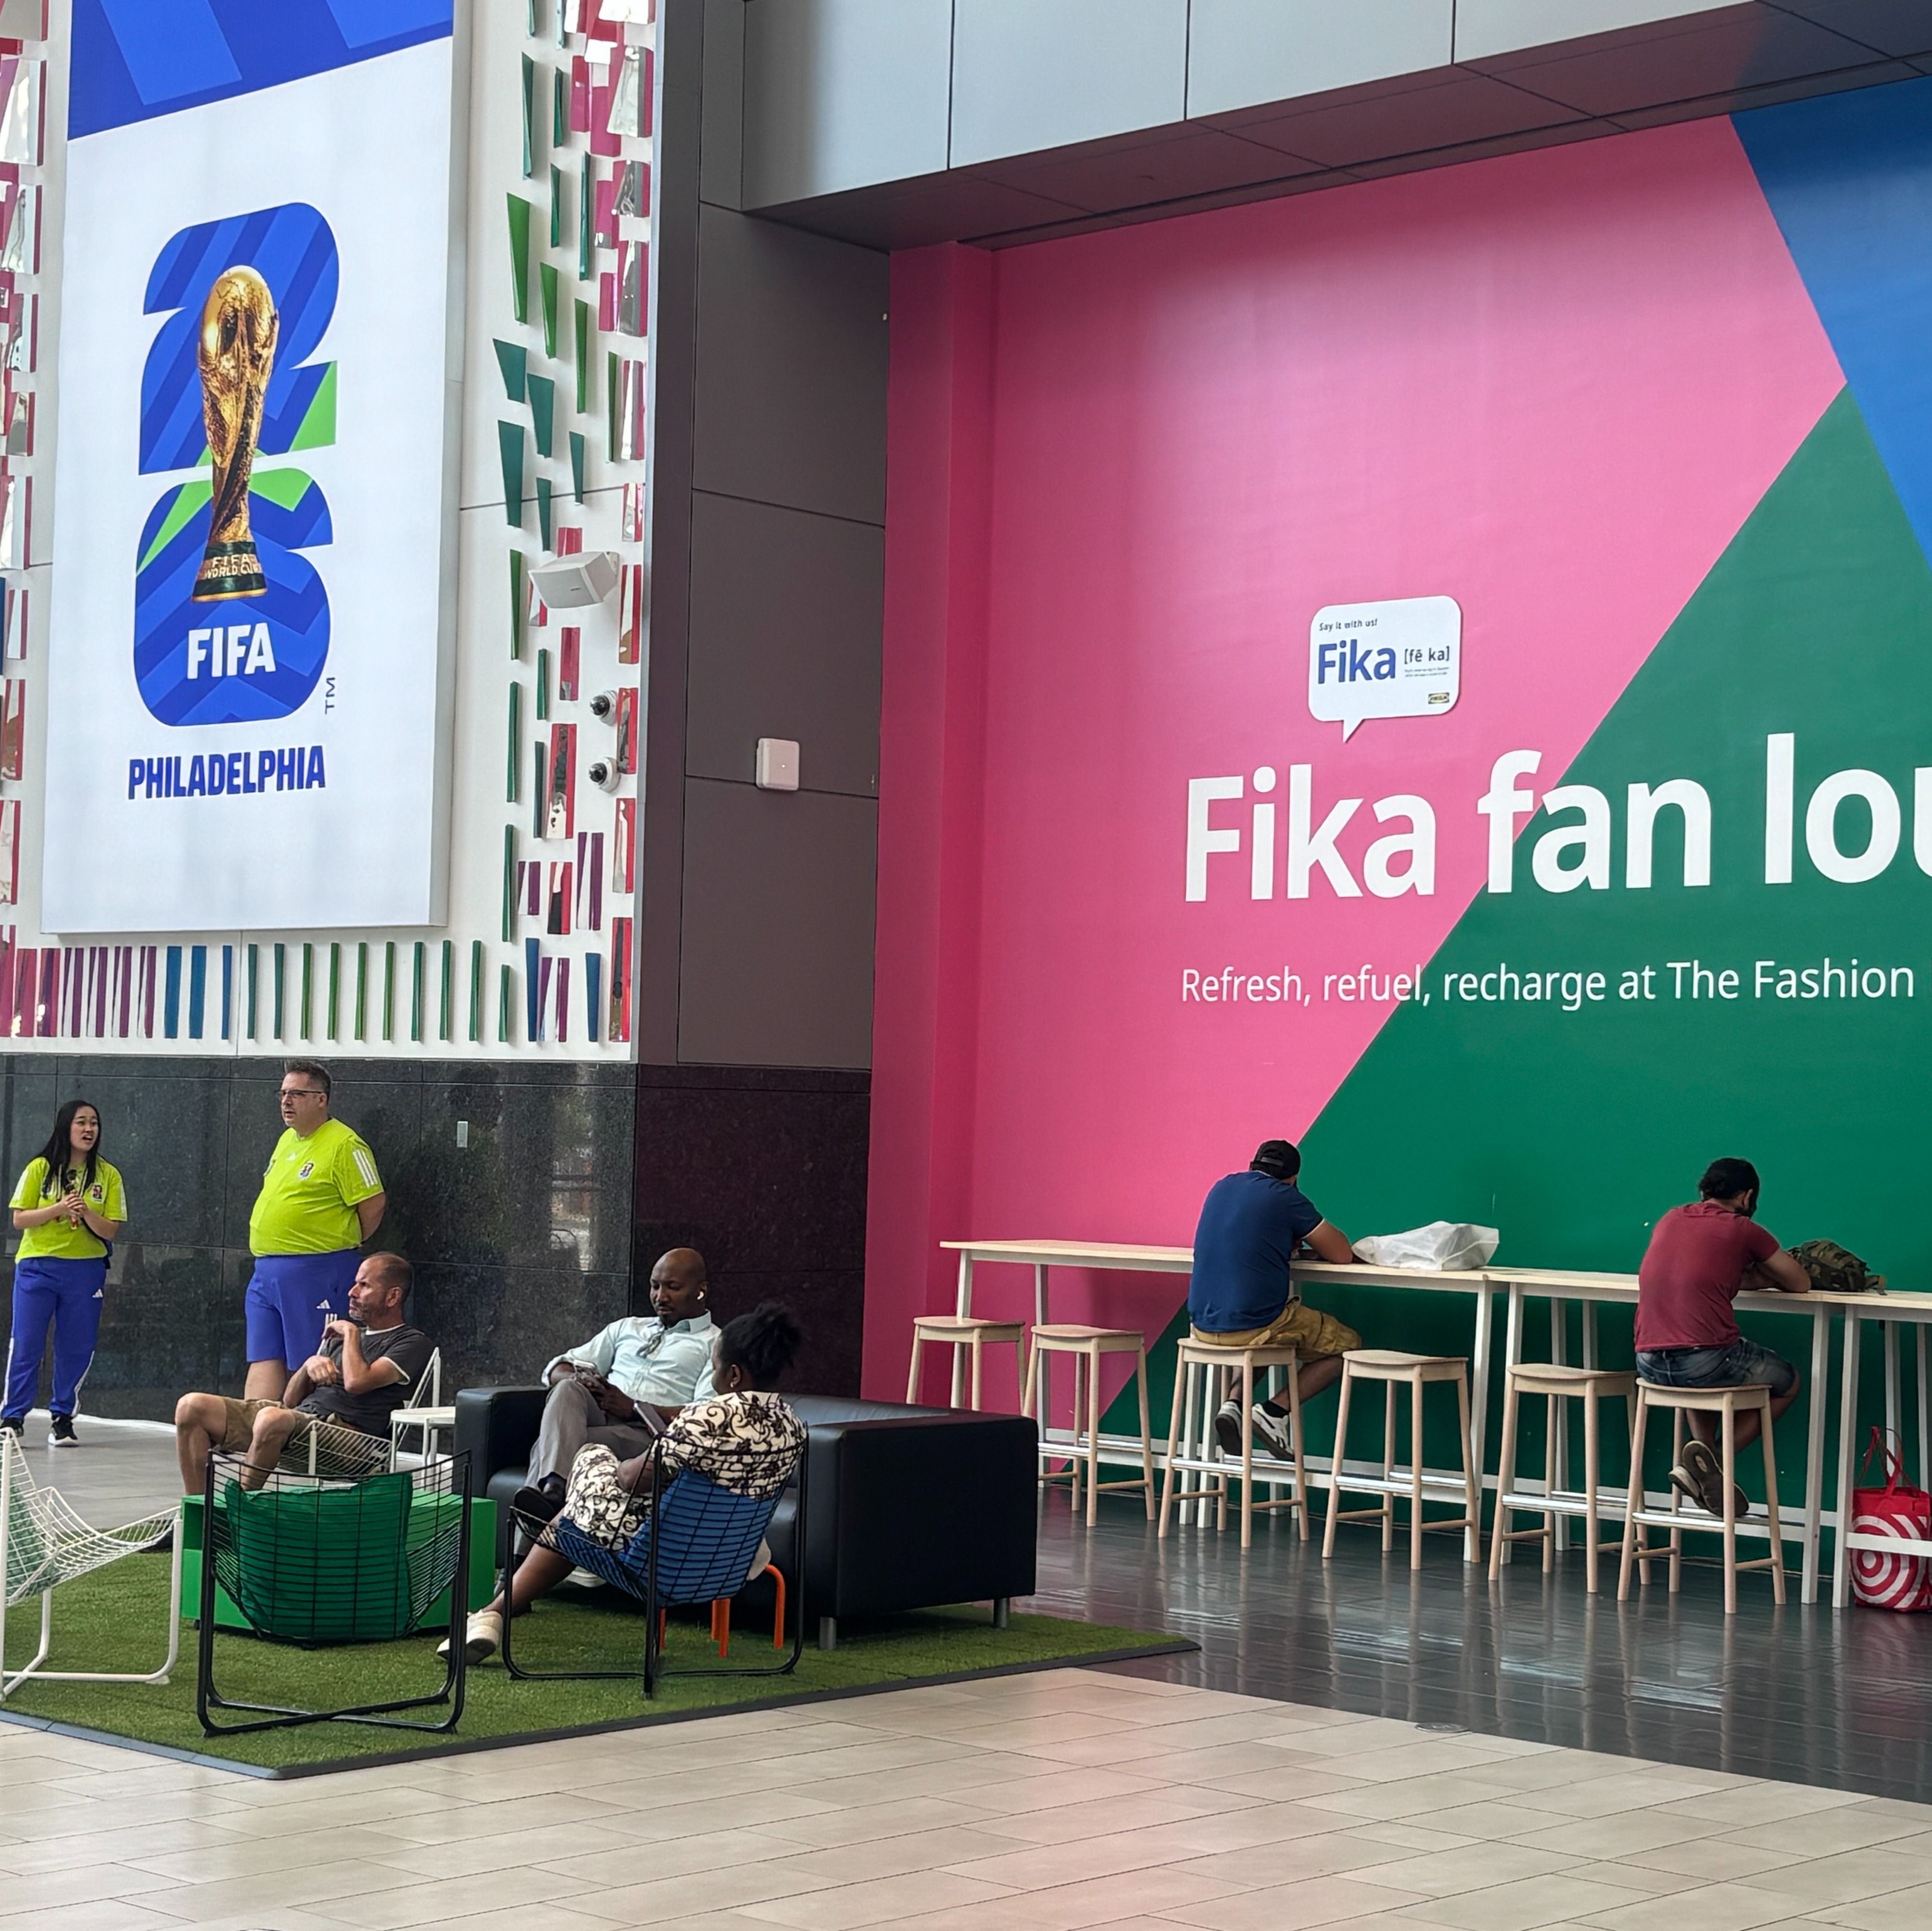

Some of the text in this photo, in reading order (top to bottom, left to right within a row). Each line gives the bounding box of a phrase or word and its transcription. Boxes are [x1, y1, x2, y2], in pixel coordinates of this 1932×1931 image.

[204, 565, 238, 579] WORLD
[213, 554, 250, 567] FIFA
[1319, 618, 1378, 632] Say it with us!
[187, 622, 276, 679] FIFA
[1317, 639, 1397, 685] Fika
[1428, 645, 1450, 662] ka]
[324, 677, 336, 715] TM
[128, 745, 326, 800] PHILADELPHIA
[1185, 732, 1932, 902] Fika fan lo
[1182, 958, 1914, 1011] Refresh, refuel, recharge at The Fashion
